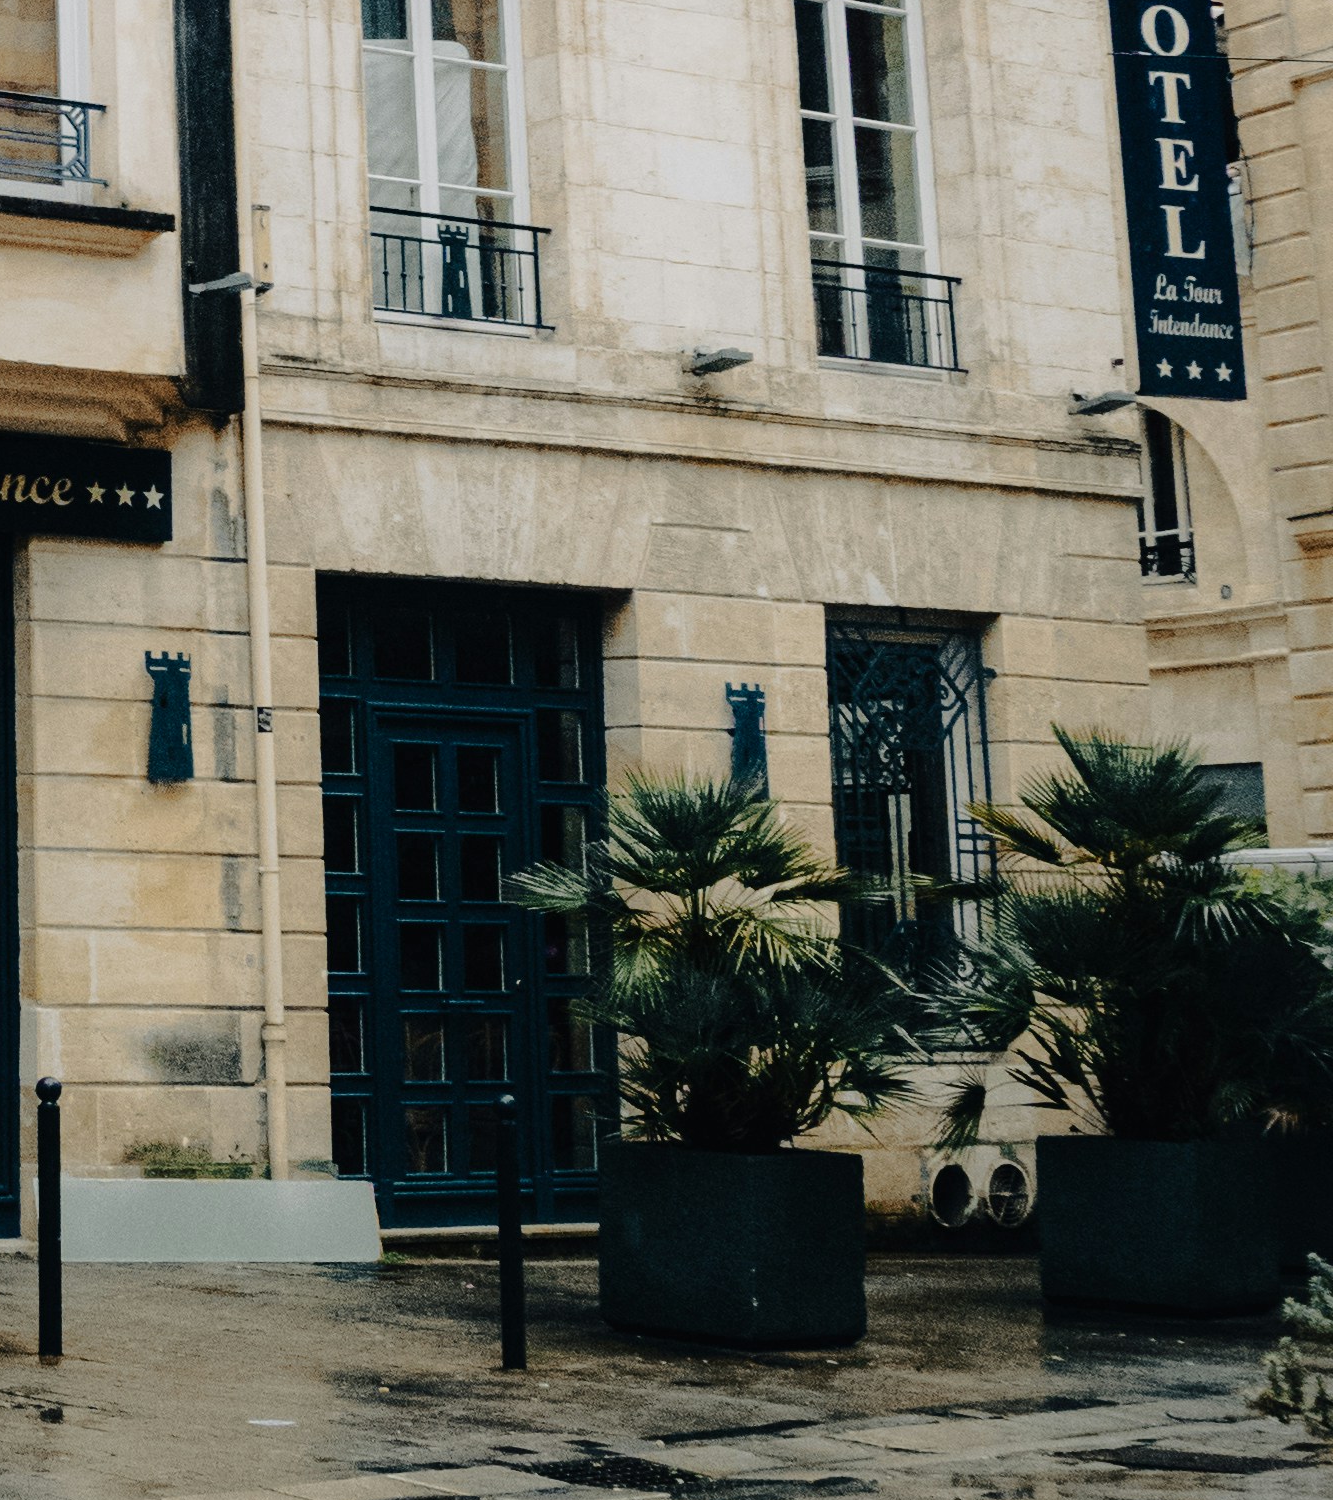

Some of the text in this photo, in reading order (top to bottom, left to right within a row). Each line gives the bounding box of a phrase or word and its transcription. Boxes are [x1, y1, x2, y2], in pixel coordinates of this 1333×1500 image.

[1153, 273, 1223, 304] La Tour
[1148, 309, 1234, 339] Intendance
